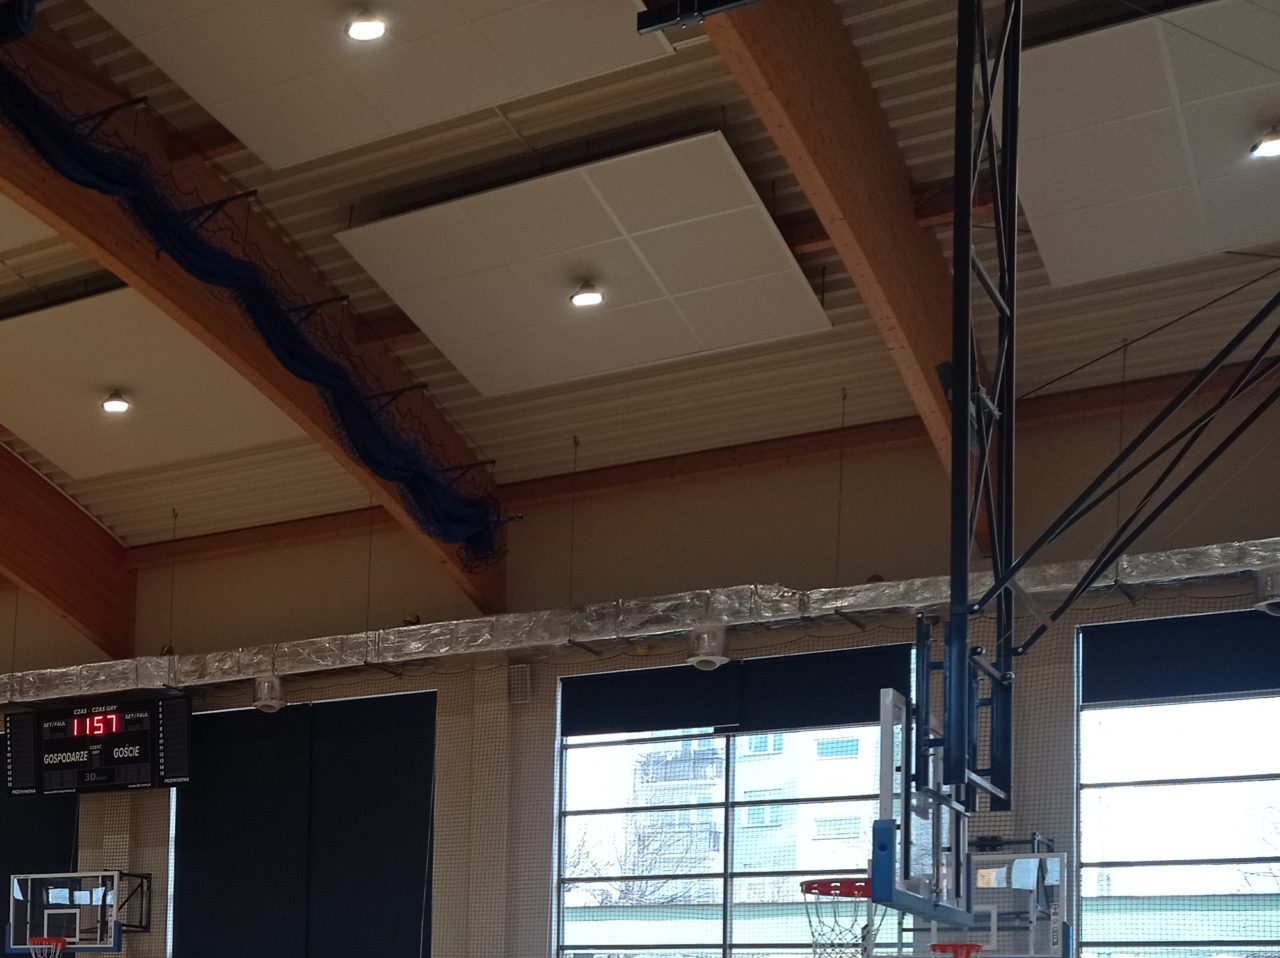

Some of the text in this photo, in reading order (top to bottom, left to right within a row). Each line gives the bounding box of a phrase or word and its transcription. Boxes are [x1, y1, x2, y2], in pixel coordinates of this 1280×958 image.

[74, 715, 116, 735] 1157
[43, 751, 88, 764] GOSPODARZE
[113, 744, 140, 758] GOŚCIE
